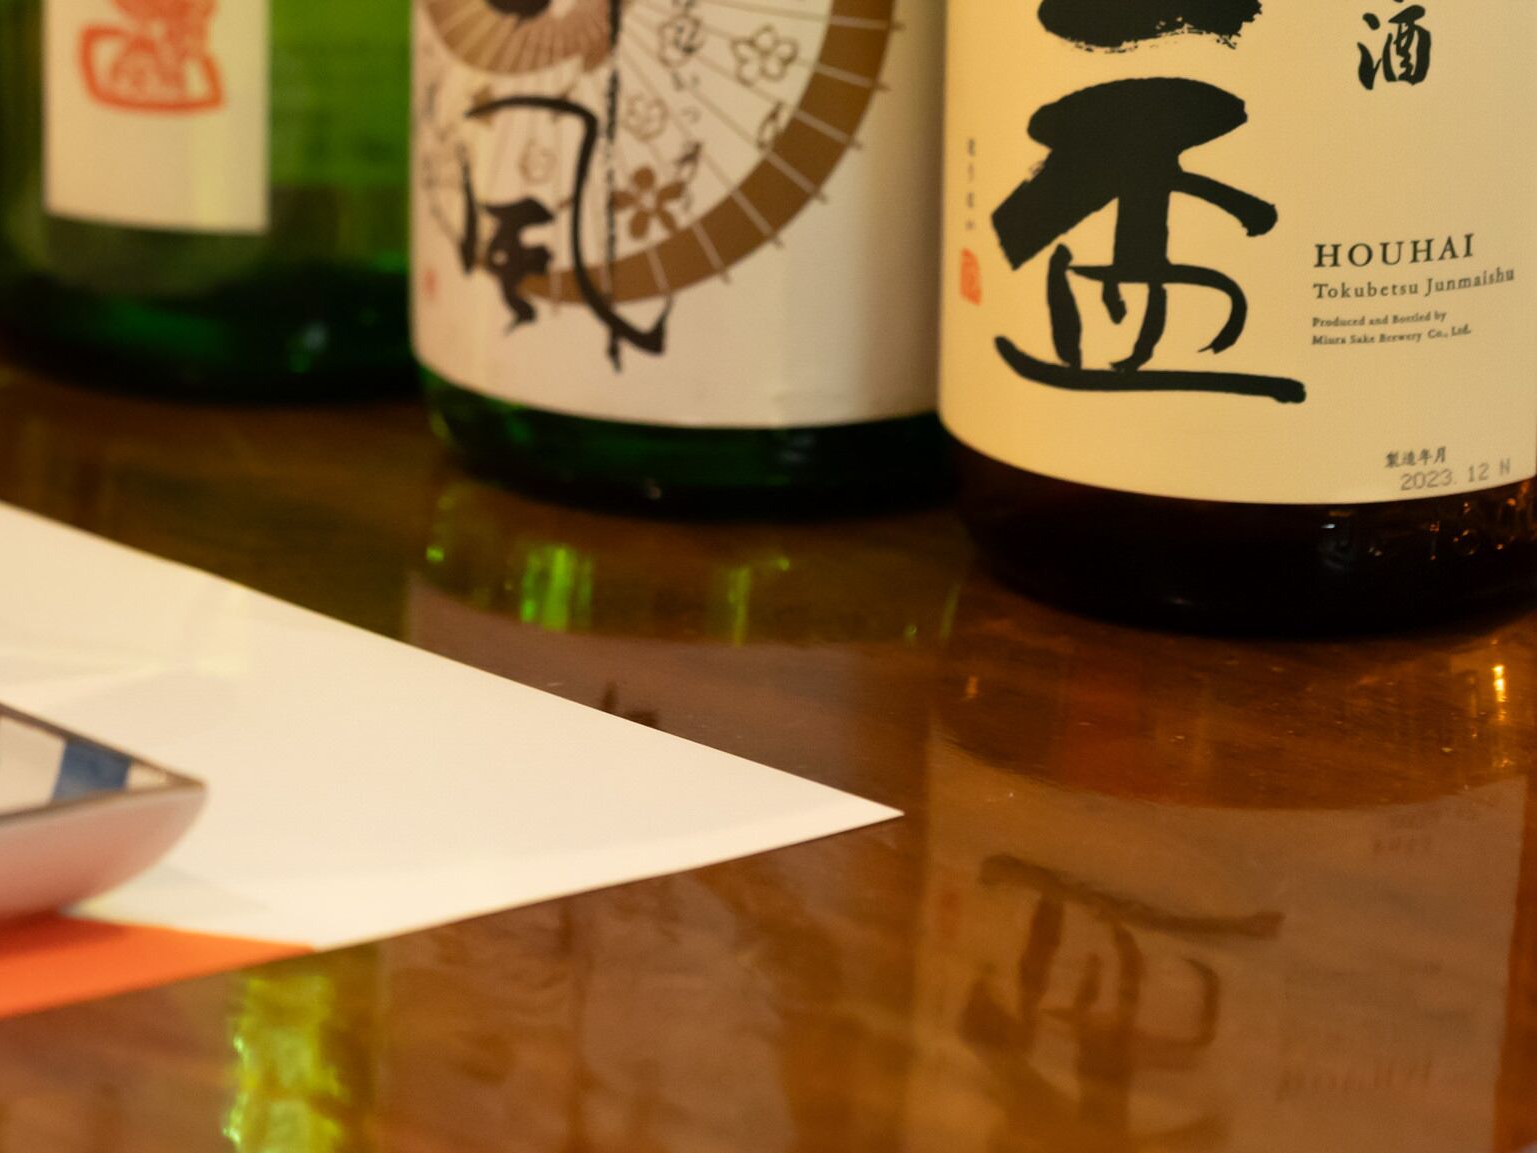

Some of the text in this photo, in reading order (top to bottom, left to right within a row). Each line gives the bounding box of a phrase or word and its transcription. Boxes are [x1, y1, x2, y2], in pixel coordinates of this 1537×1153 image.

[1314, 232, 1475, 269] HOUHAI
[1313, 266, 1515, 299] Tokubetsu Junmaishu
[1312, 310, 1448, 328] Produced and Bottled by
[1312, 333, 1346, 346] Miura
[1349, 332, 1376, 344] Sake
[1378, 332, 1423, 344] Brewery
[1467, 462, 1490, 483] 12
